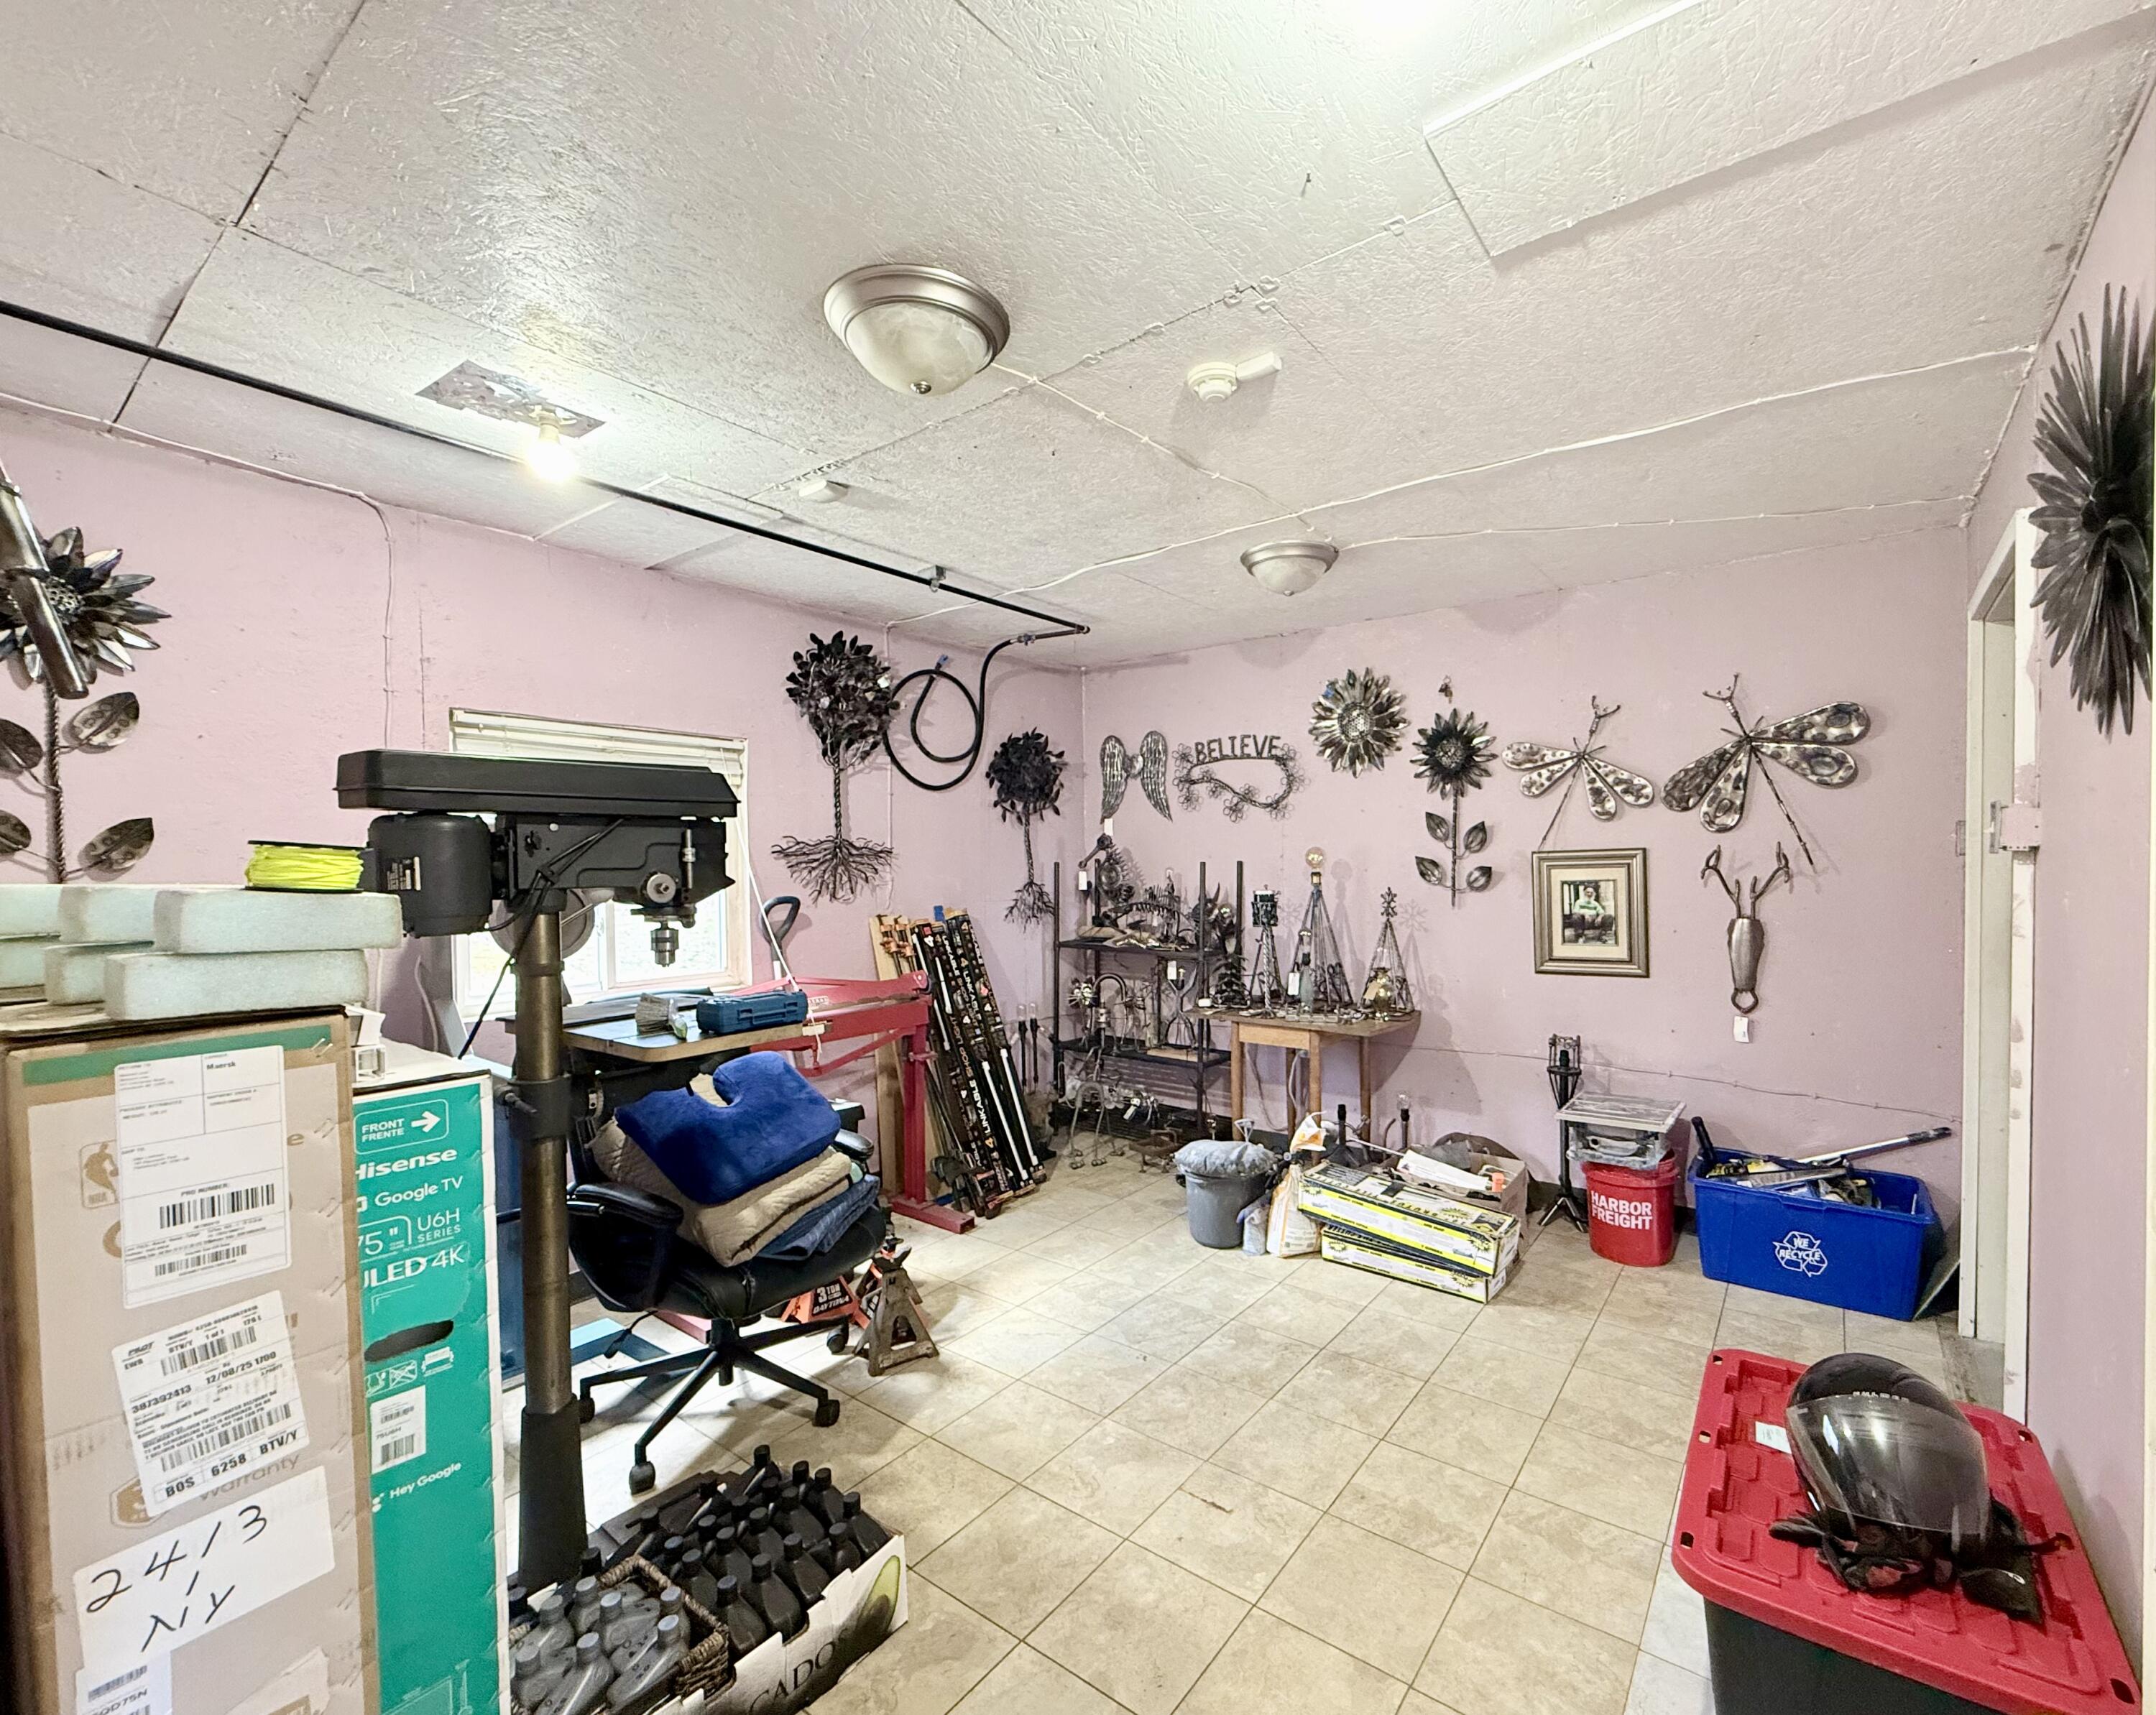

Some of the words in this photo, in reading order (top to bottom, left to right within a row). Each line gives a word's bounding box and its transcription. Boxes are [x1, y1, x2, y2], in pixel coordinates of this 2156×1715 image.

[1194, 734, 1281, 764] BELIEVE
[941, 935, 960, 976] LINKABLE
[949, 1015, 963, 1045] LIGHT
[206, 1060, 236, 1070] Maersk
[959, 1046, 973, 1077] SHOP
[969, 1078, 991, 1133] LINKABLE
[361, 1118, 405, 1134] FRONT
[361, 1127, 405, 1142] FRENTE
[374, 1183, 439, 1207] Google
[441, 1175, 464, 1192] TV
[1590, 1190, 1652, 1216] HARBOR
[417, 1207, 460, 1231] U6H
[1592, 1203, 1653, 1230] FREIGHT
[418, 1224, 461, 1244] SERIES
[1793, 1237, 1810, 1247] WE
[431, 1244, 465, 1268] 4K
[1779, 1249, 1821, 1261] RECYCLE
[813, 1295, 849, 1314] DAYTONA
[816, 1287, 828, 1303] 3
[826, 1283, 841, 1295] TON
[206, 1361, 253, 1385] 12/08/25
[259, 1430, 298, 1456] BTV/Y
[211, 1453, 247, 1477] 6258
[165, 1476, 195, 1498] BOS
[390, 1482, 415, 1499] Hey
[417, 1462, 462, 1487] Google
